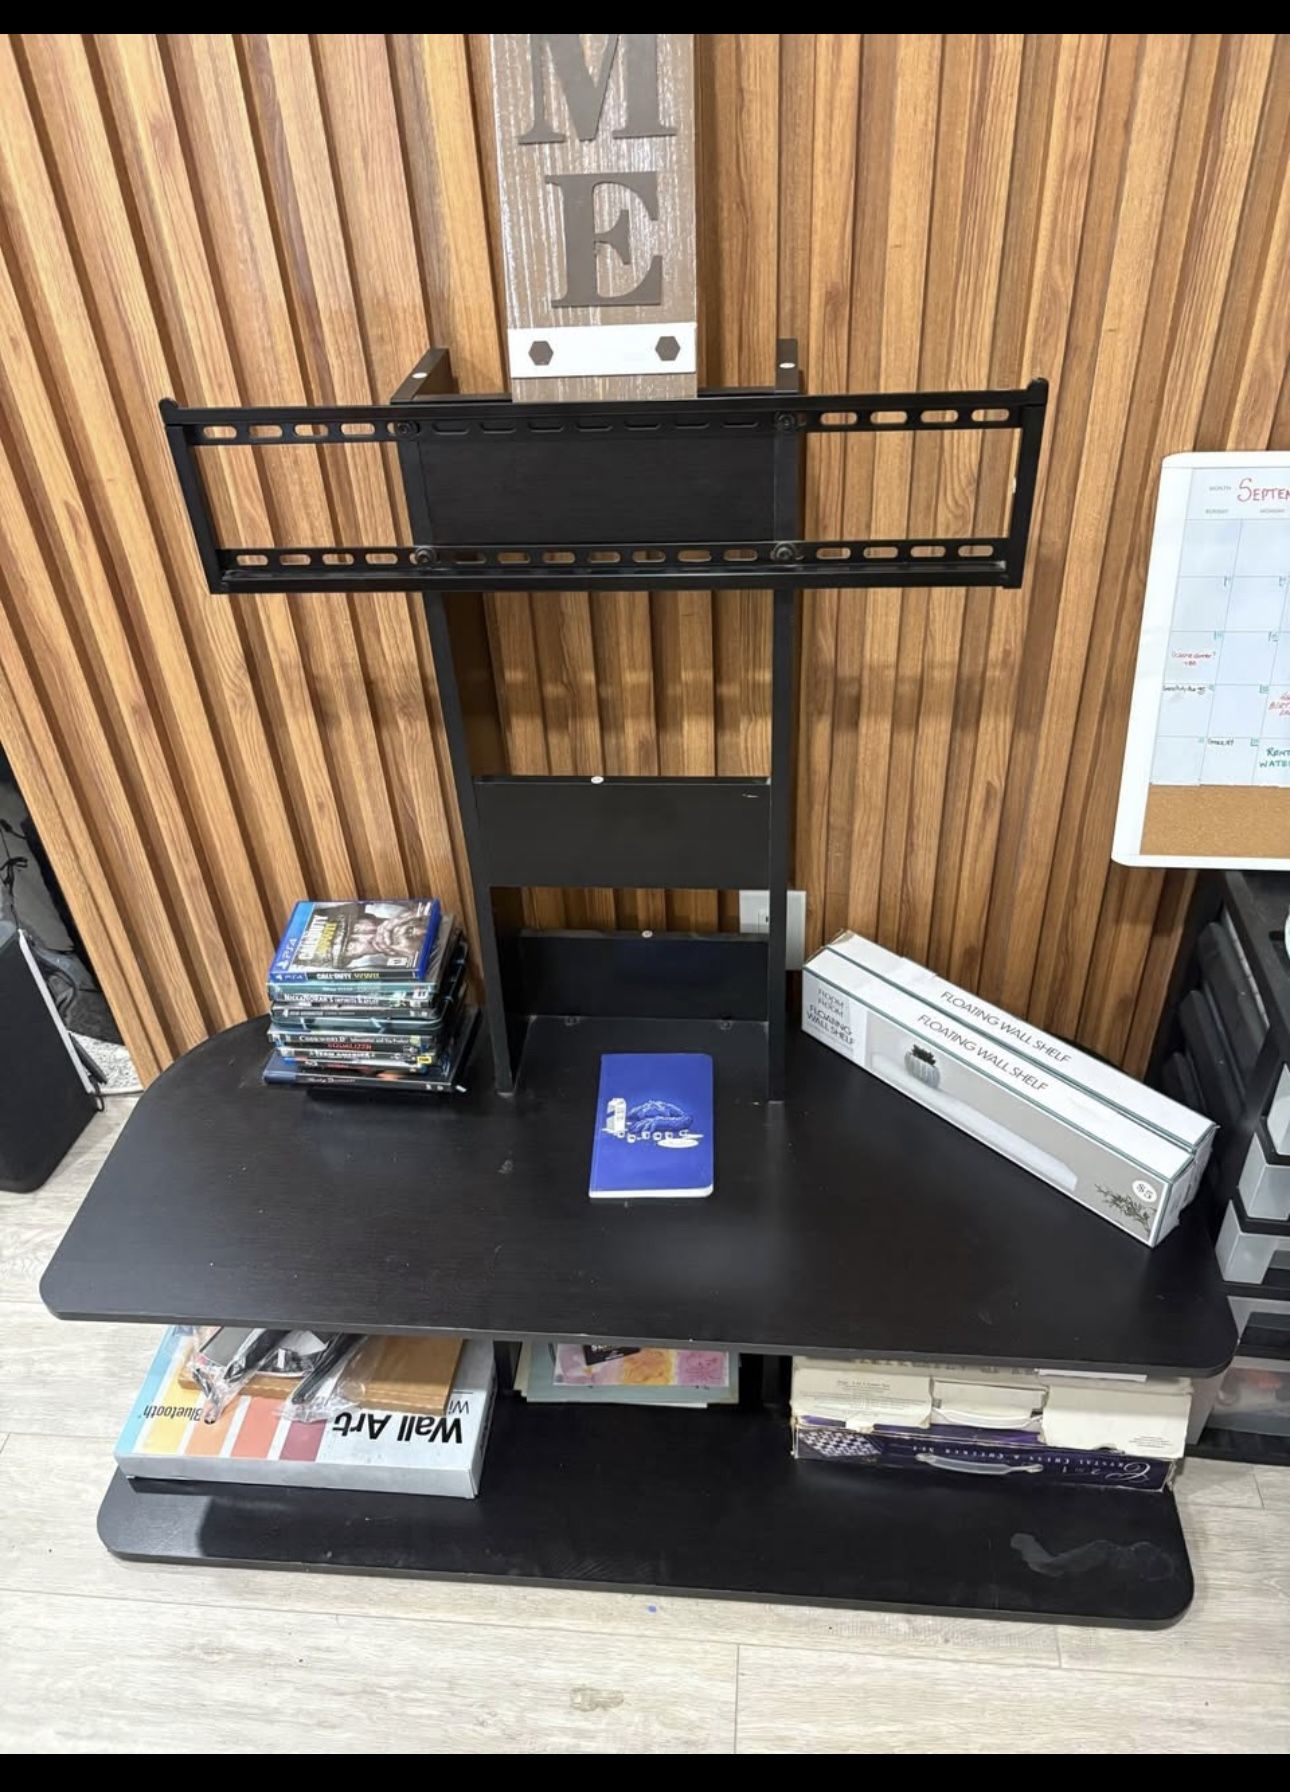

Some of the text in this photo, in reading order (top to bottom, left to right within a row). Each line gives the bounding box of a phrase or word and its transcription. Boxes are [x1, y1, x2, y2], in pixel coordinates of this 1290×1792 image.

[918, 1014, 1049, 1090] FLOATING WALL SHELF
[940, 991, 1072, 1062] FLOATING WALL SHELF
[332, 1412, 462, 1444] Wall Art
